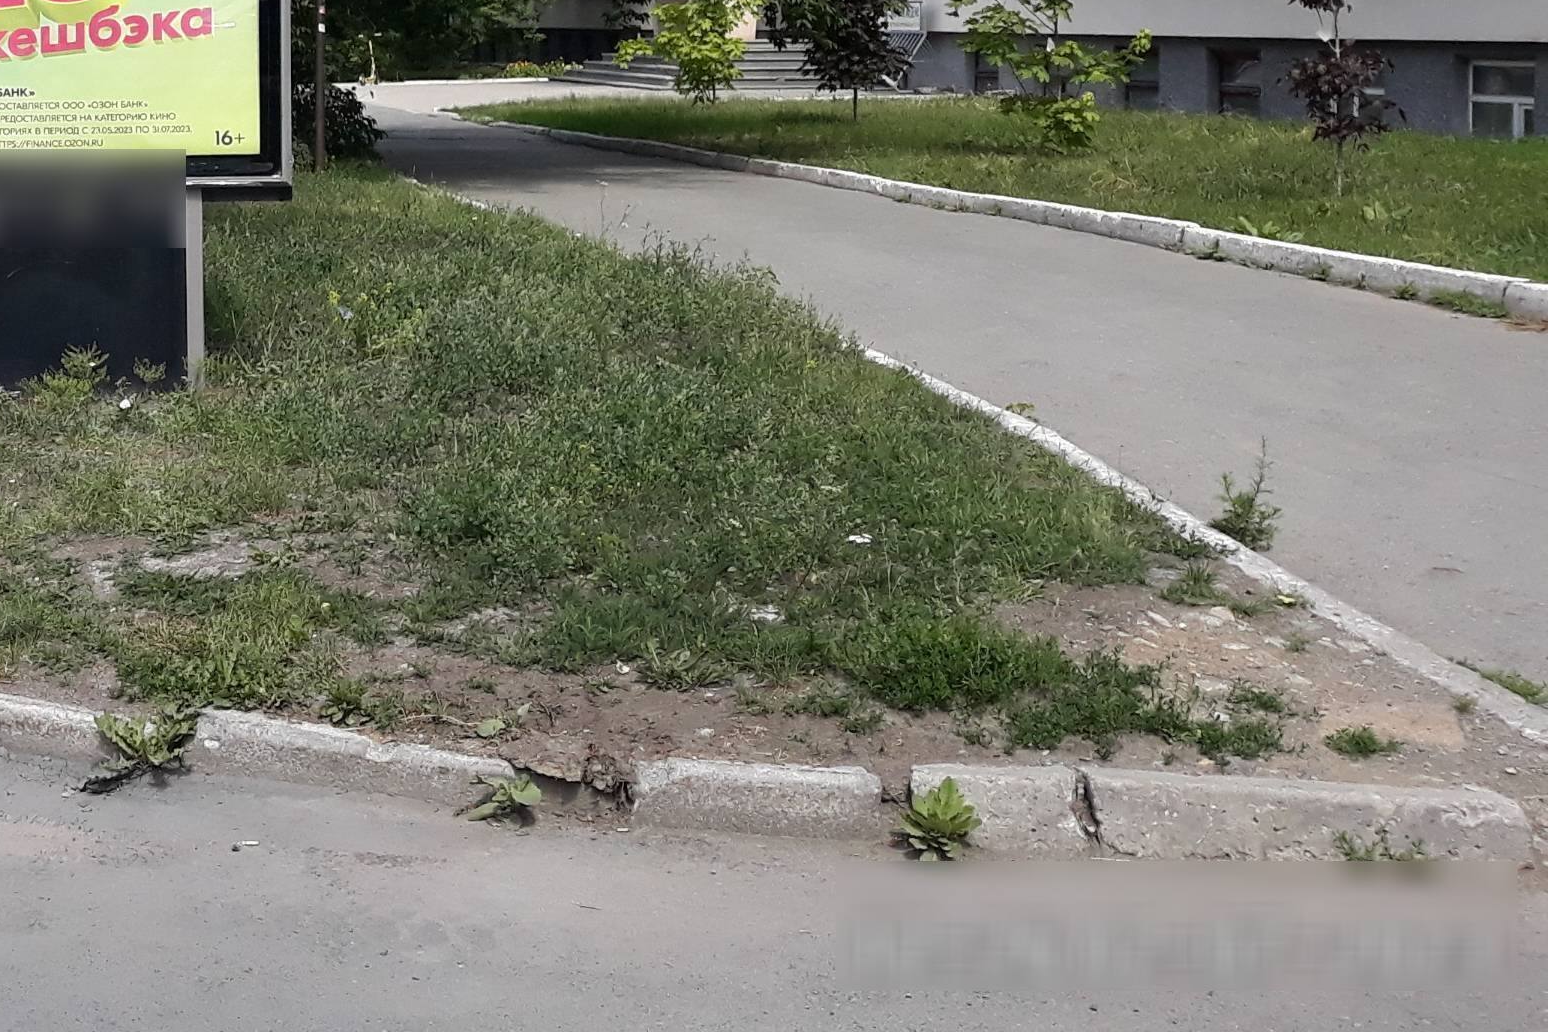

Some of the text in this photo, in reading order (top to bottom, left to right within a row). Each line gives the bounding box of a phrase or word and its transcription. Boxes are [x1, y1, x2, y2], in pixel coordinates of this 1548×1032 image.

[61, 100, 85, 110] ООО
[79, 113, 93, 123] НА
[94, 112, 148, 122] КАТЕГОРИЮ
[150, 111, 177, 121] КИНО
[34, 126, 42, 136] В
[43, 126, 80, 136] ПЕРИОД
[81, 126, 89, 135] С
[135, 125, 150, 134] ПО
[214, 129, 246, 147] 16+
